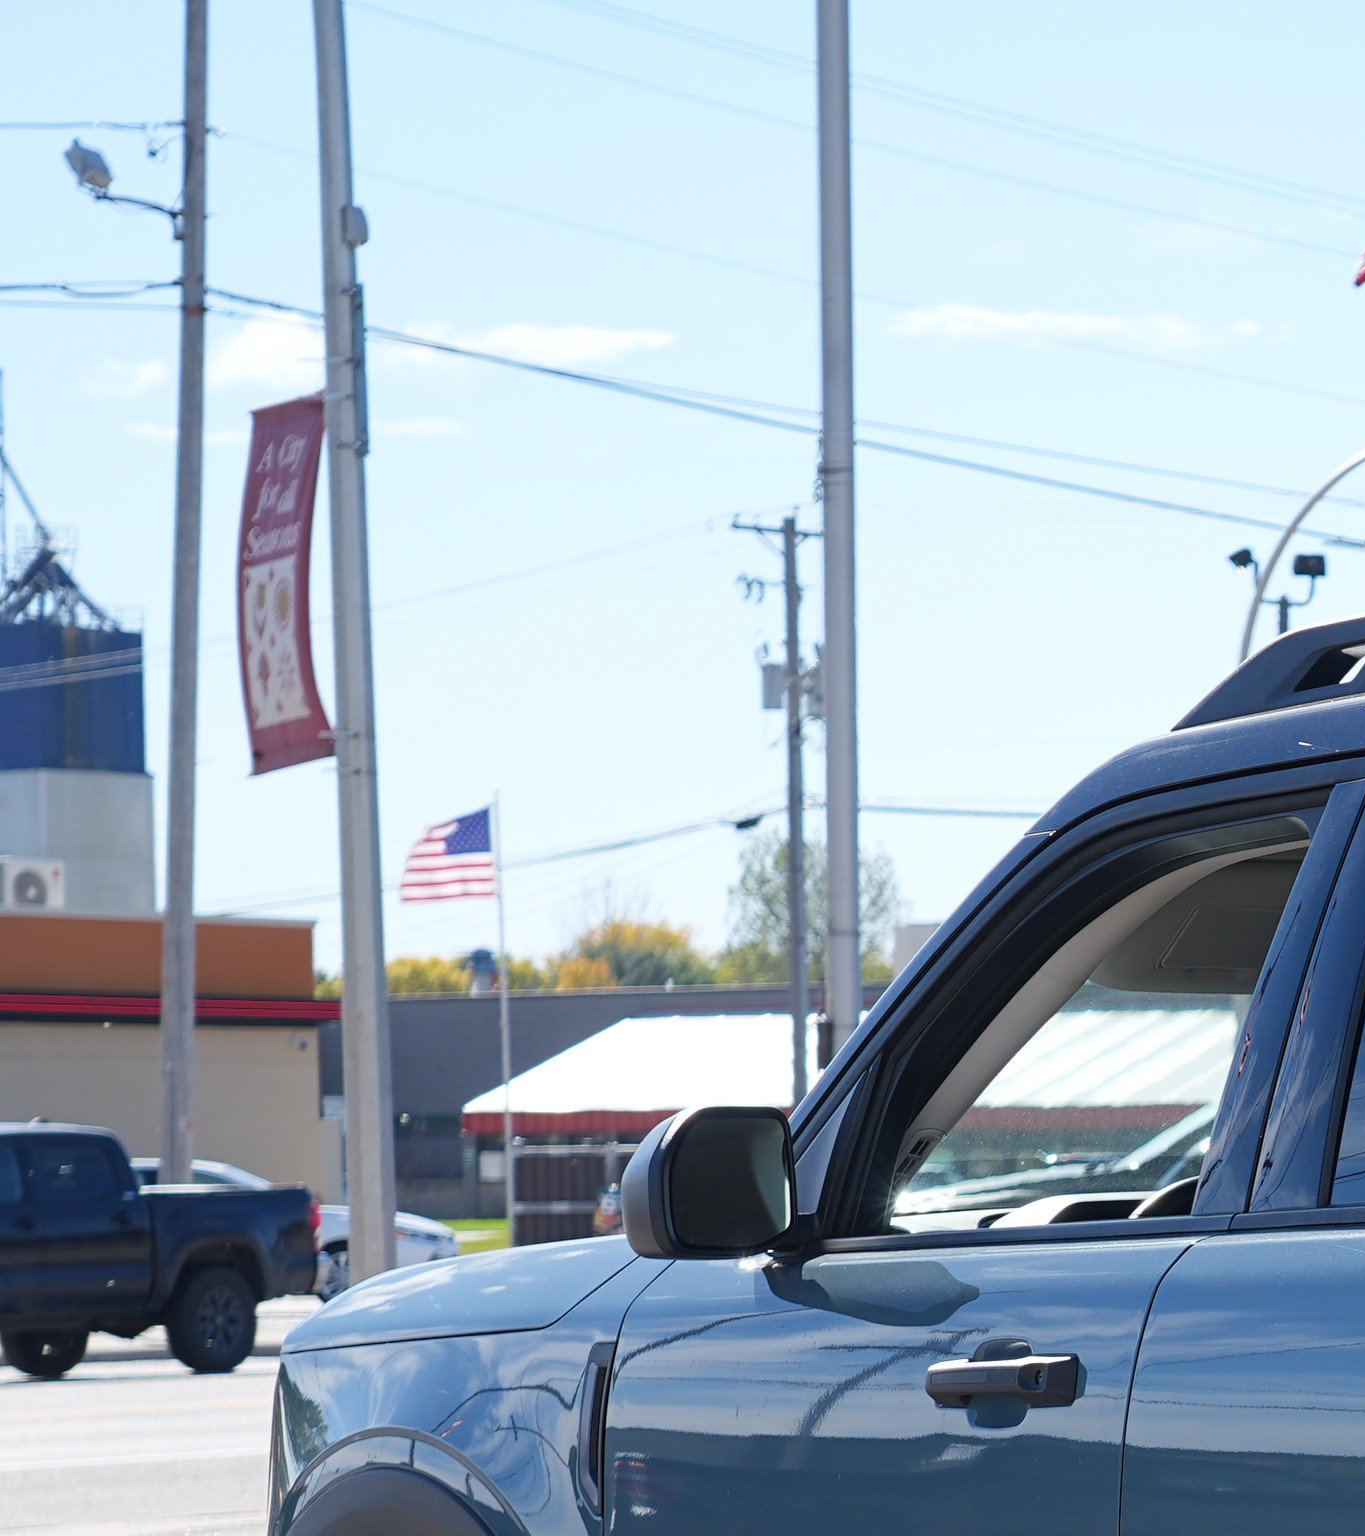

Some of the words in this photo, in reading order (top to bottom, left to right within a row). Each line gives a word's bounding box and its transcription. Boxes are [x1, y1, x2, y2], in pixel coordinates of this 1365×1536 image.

[256, 440, 274, 472] A
[278, 432, 307, 472] City
[251, 477, 281, 522] for
[276, 479, 298, 514] all
